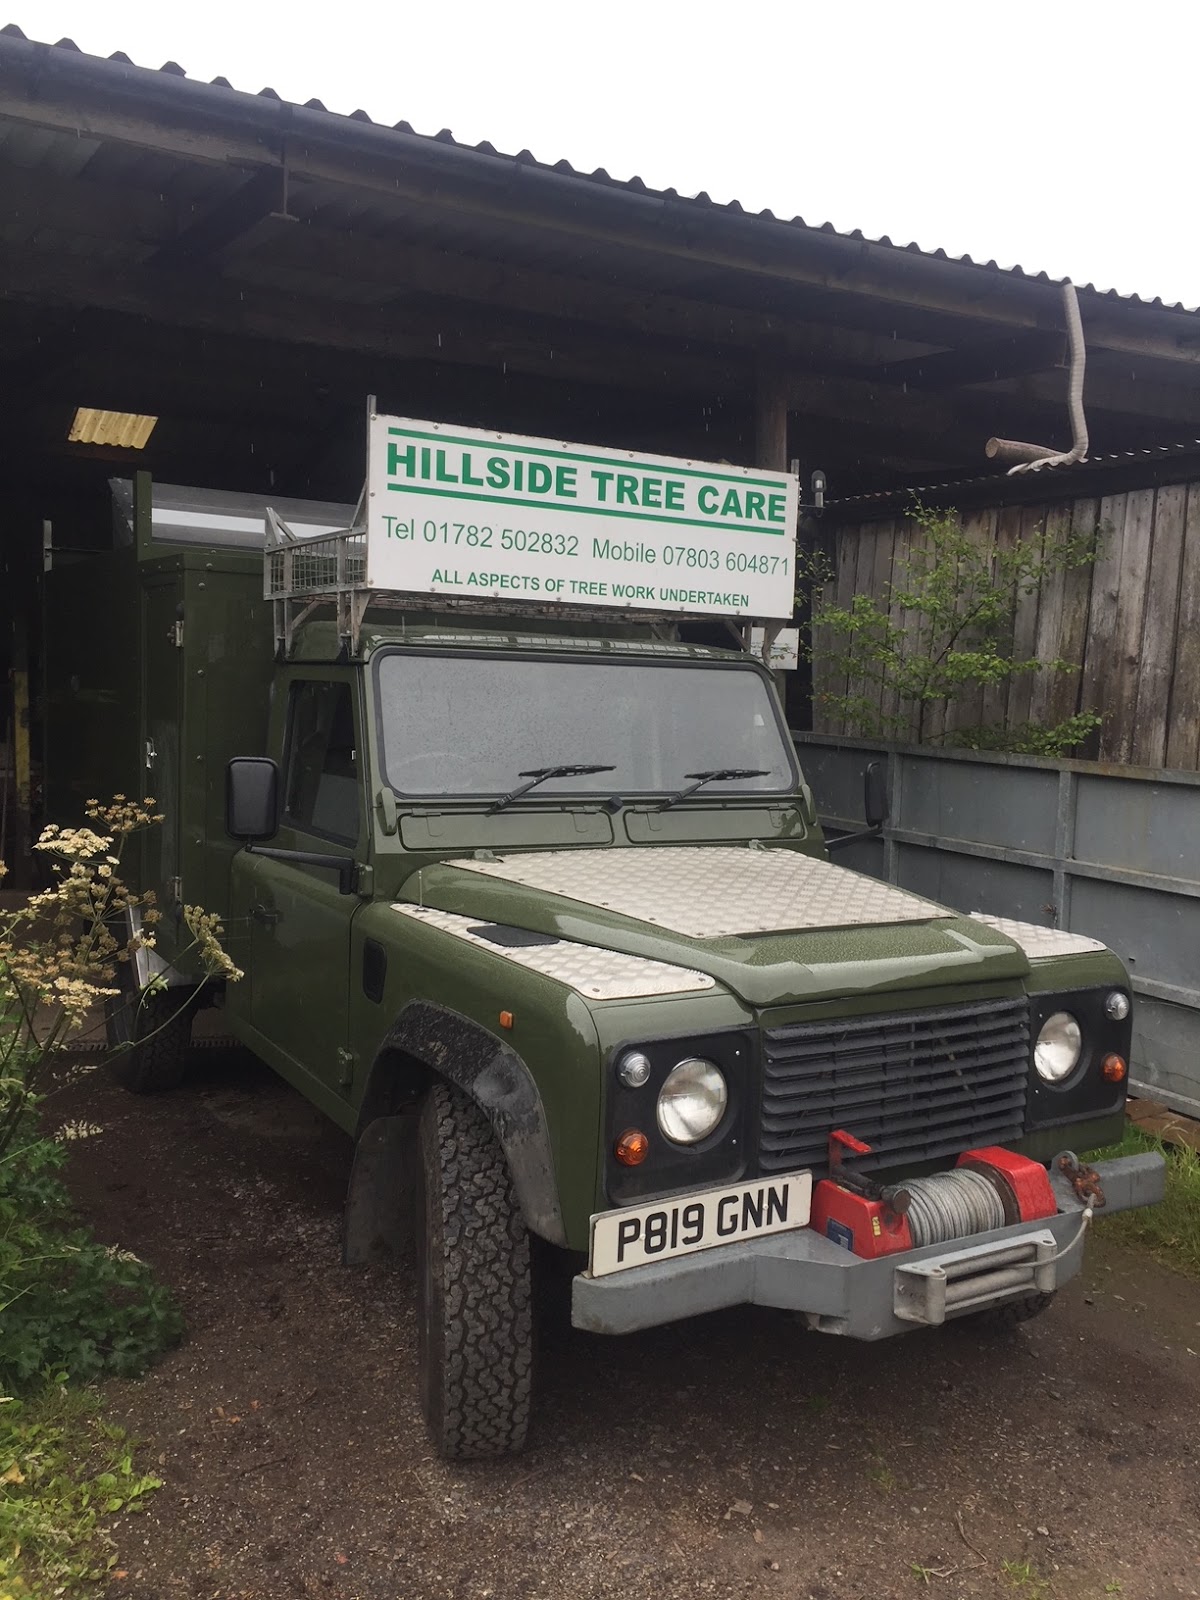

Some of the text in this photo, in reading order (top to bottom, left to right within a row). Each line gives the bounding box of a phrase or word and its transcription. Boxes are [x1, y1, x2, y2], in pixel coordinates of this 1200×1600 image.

[387, 442, 787, 523] HILLSIDE TREE CARE
[381, 515, 789, 577] Tel 01782 502832 Mobile 07803 604871
[431, 568, 749, 608] ALL ASPECTS OF TREE WORK UNDERTAKEN
[617, 1203, 704, 1262] P819
[717, 1184, 788, 1235] GNN
